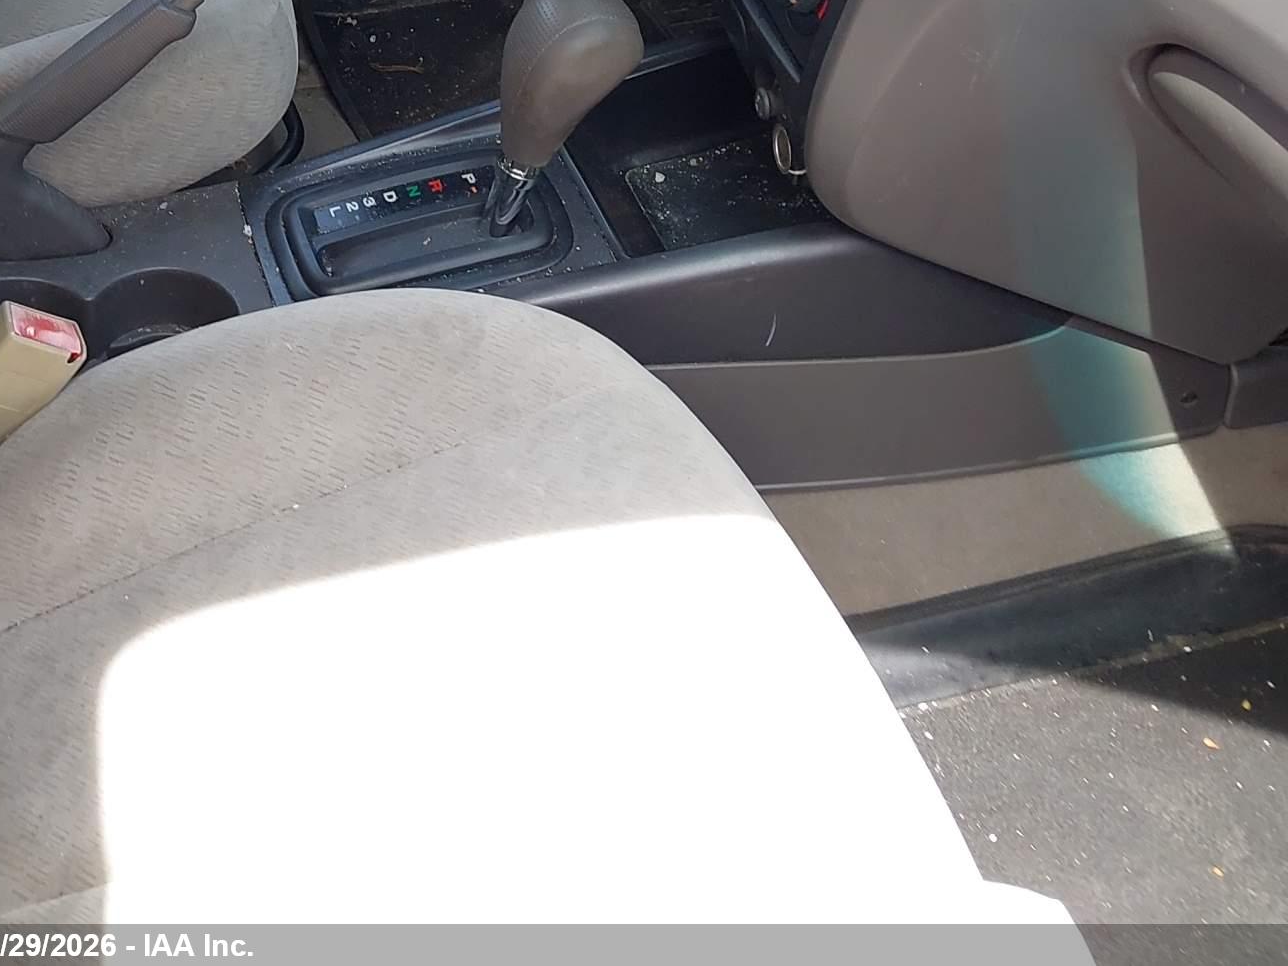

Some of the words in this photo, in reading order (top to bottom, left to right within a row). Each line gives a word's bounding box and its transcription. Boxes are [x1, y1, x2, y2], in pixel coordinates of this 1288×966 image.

[461, 172, 476, 185] P
[406, 185, 421, 198] N
[428, 179, 444, 193] R
[362, 196, 376, 208] 3
[383, 190, 398, 203] D
[329, 206, 341, 218] L
[345, 201, 359, 213] 2
